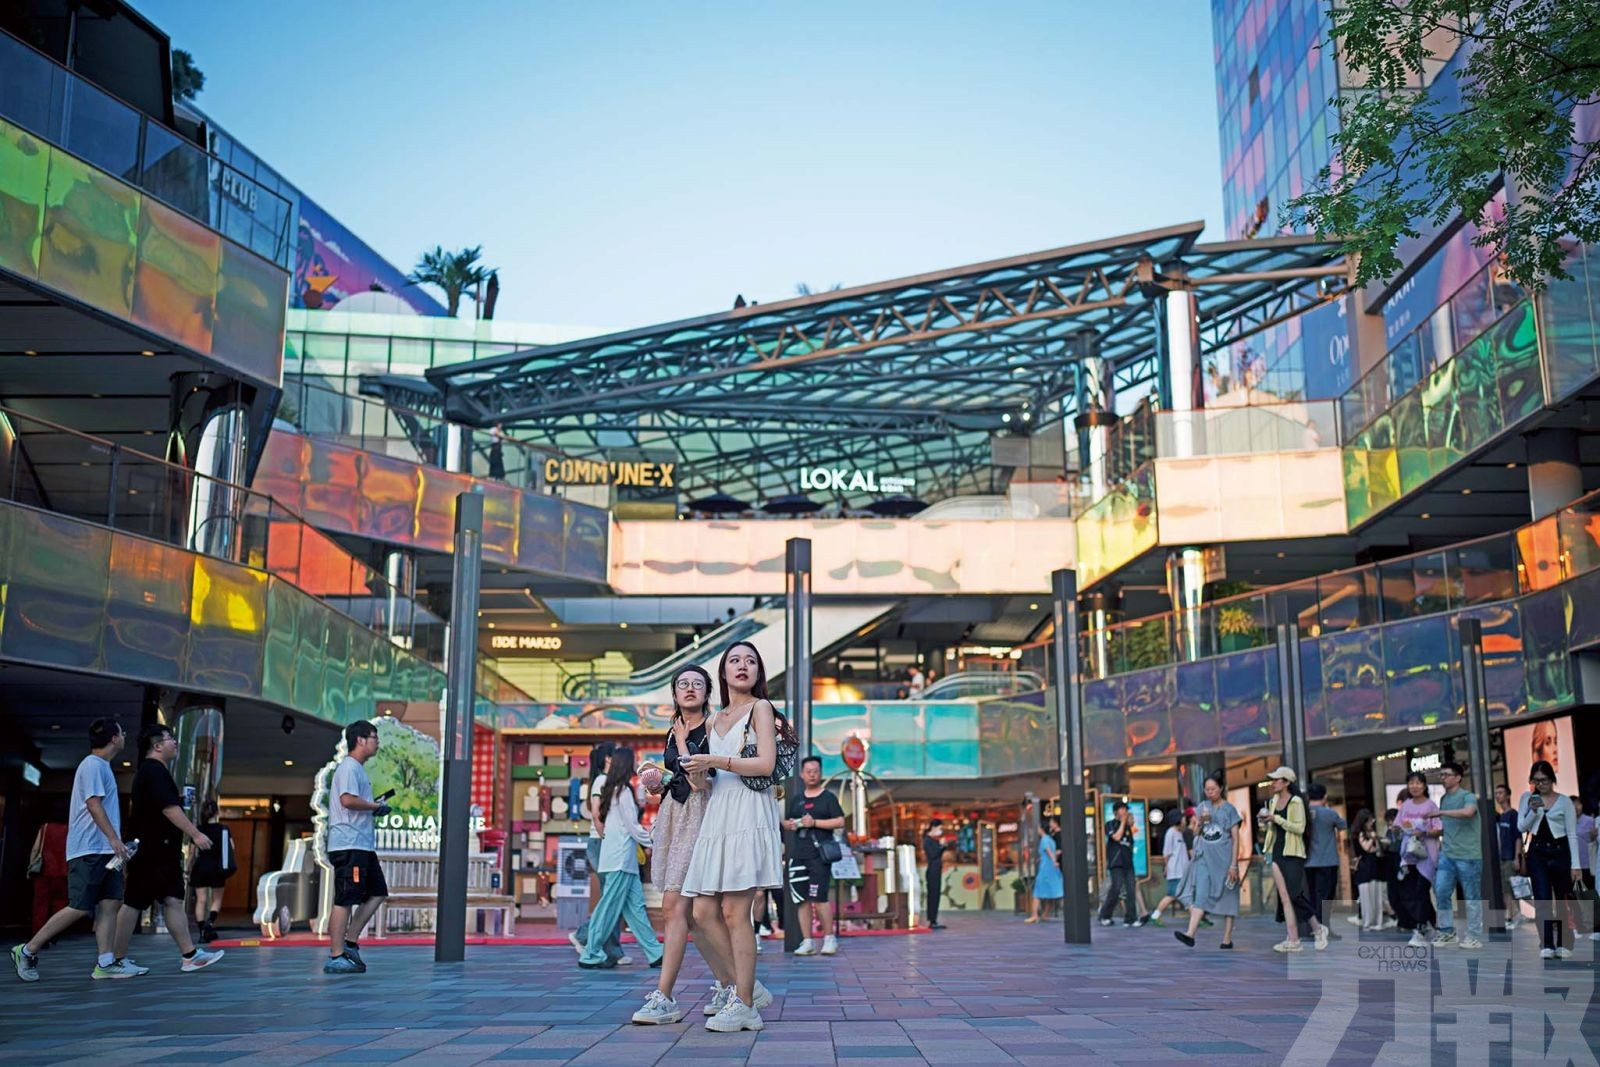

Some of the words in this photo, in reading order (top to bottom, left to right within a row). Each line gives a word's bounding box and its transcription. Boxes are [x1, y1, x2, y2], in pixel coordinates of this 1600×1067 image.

[222, 170, 258, 212] CLUB
[800, 466, 879, 492] LOKAL
[519, 636, 562, 650] MARZO
[378, 814, 404, 829] JO
